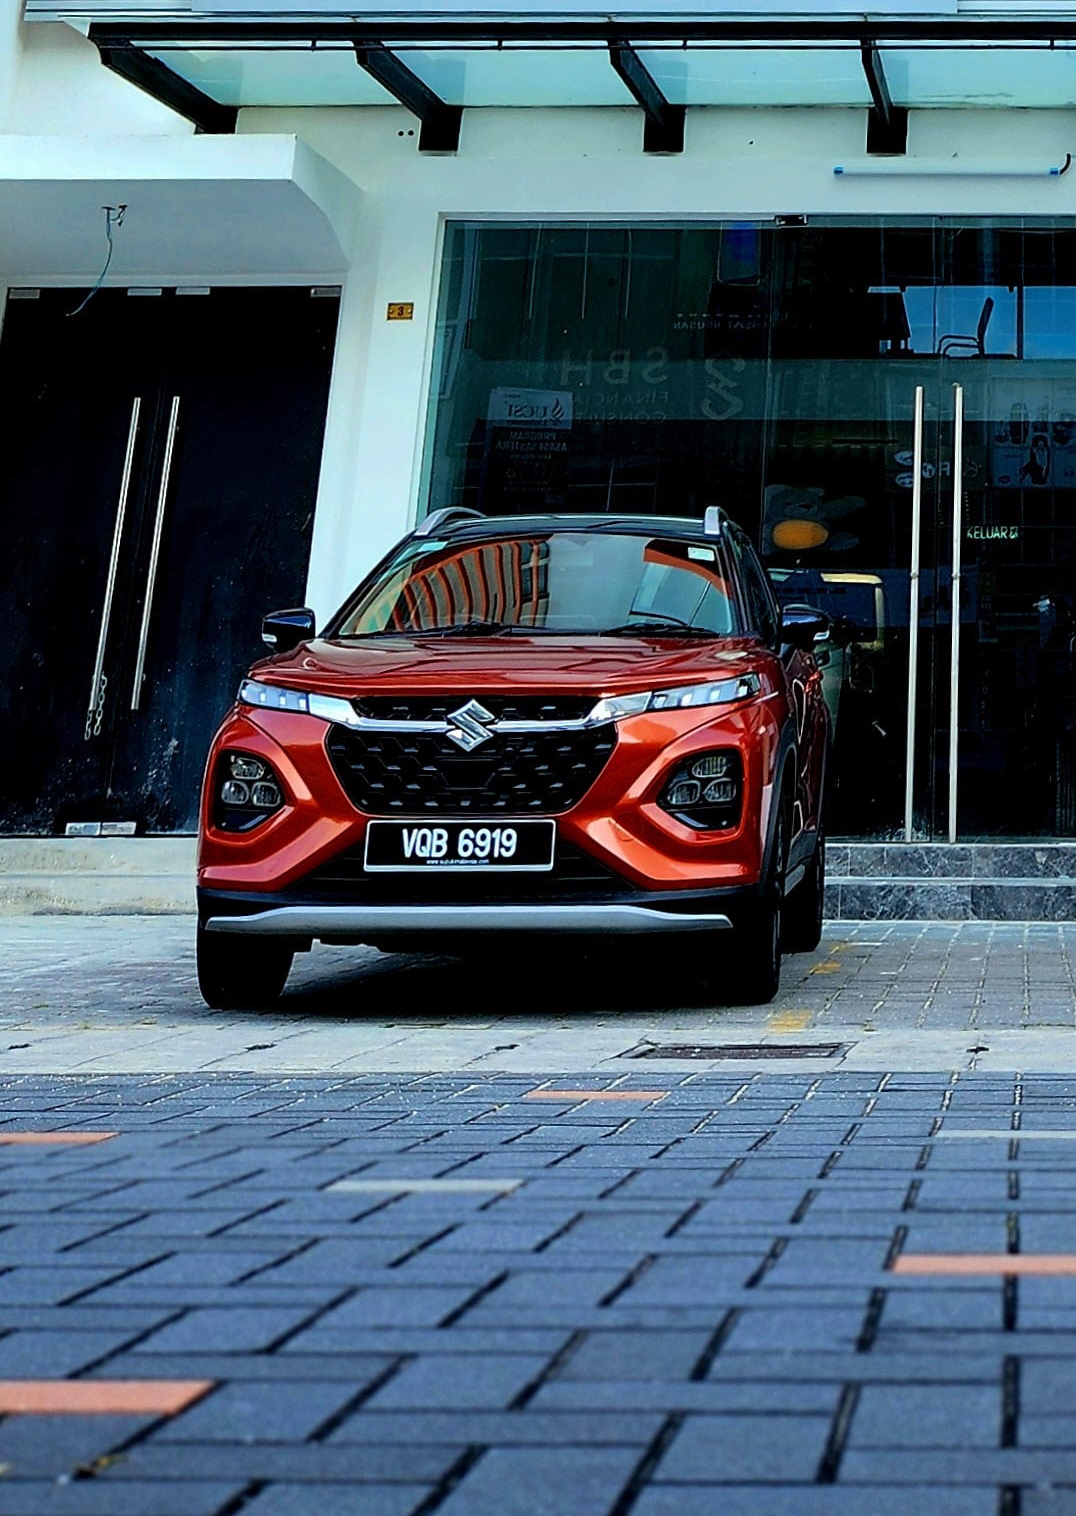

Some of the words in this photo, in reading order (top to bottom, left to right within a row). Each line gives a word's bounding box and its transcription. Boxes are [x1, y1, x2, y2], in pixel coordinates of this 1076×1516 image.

[397, 306, 404, 317] 3
[966, 525, 1008, 540] KELUAR
[402, 828, 448, 859] VQB
[457, 828, 518, 859] 6919
